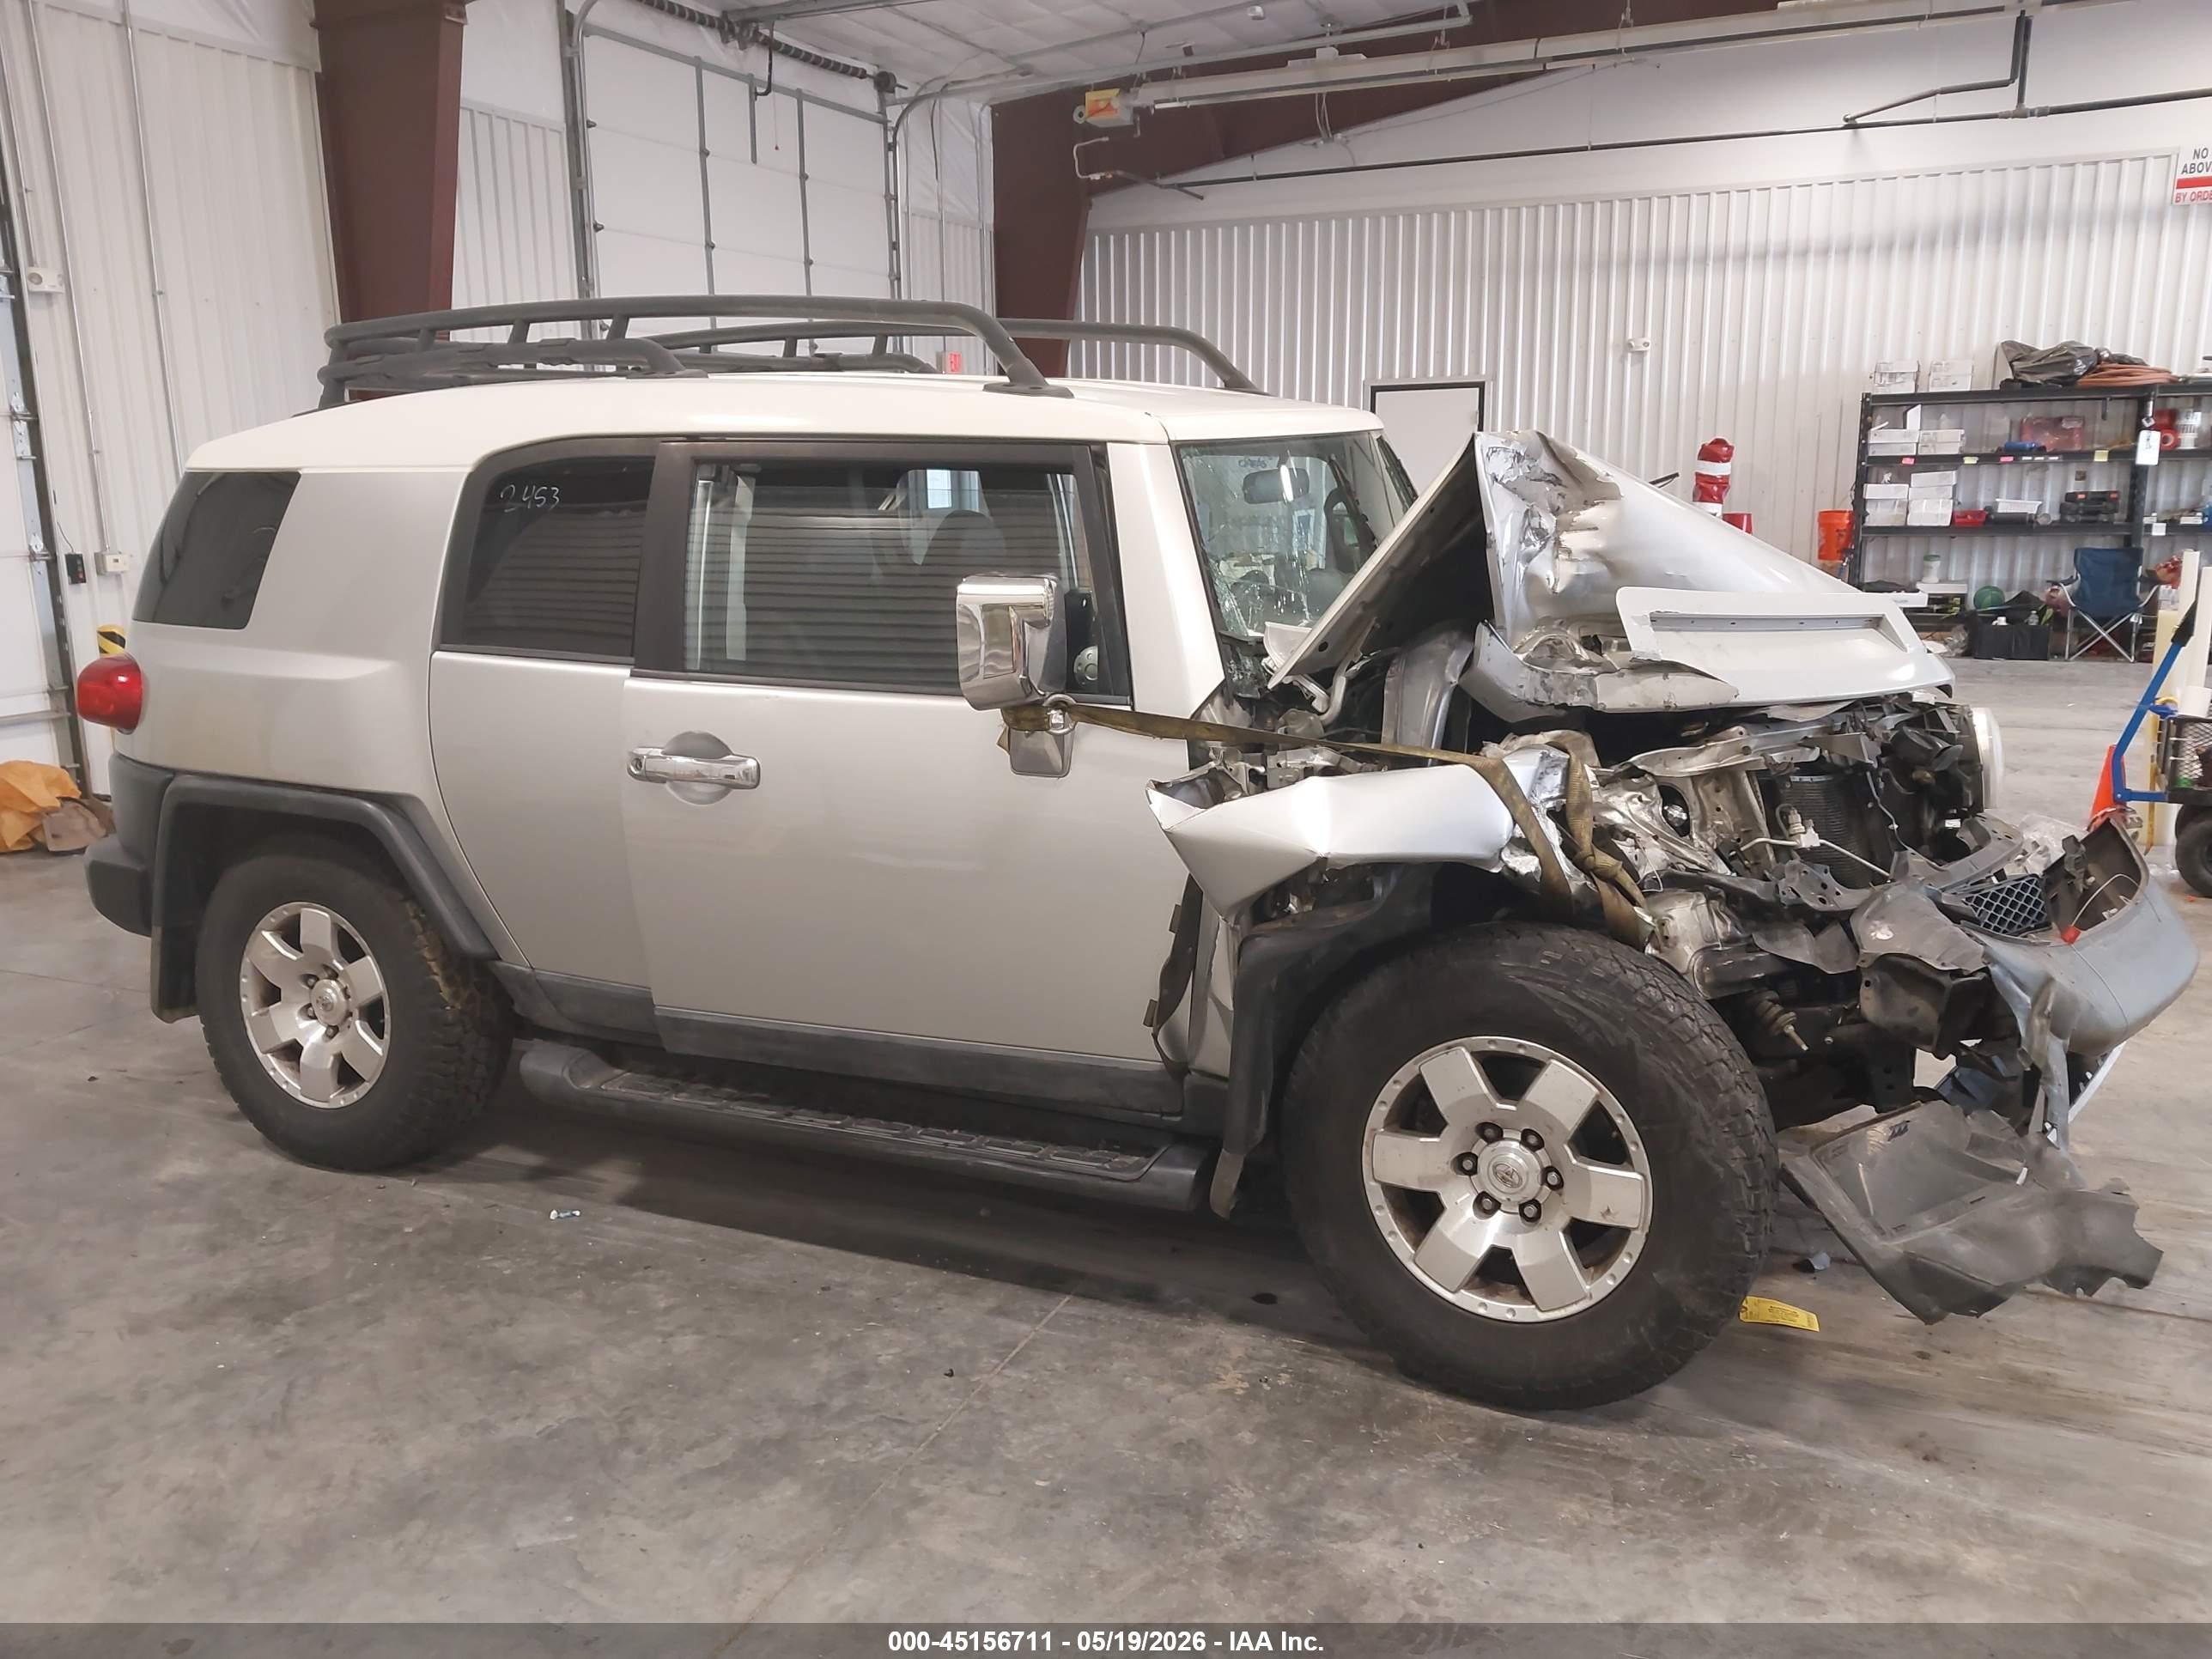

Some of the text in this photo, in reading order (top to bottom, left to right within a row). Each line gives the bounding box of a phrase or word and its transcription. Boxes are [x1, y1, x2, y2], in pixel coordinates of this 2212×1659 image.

[2193, 148, 2209, 160] NO
[2181, 161, 2212, 174] ABOV
[2175, 192, 2187, 203] BY
